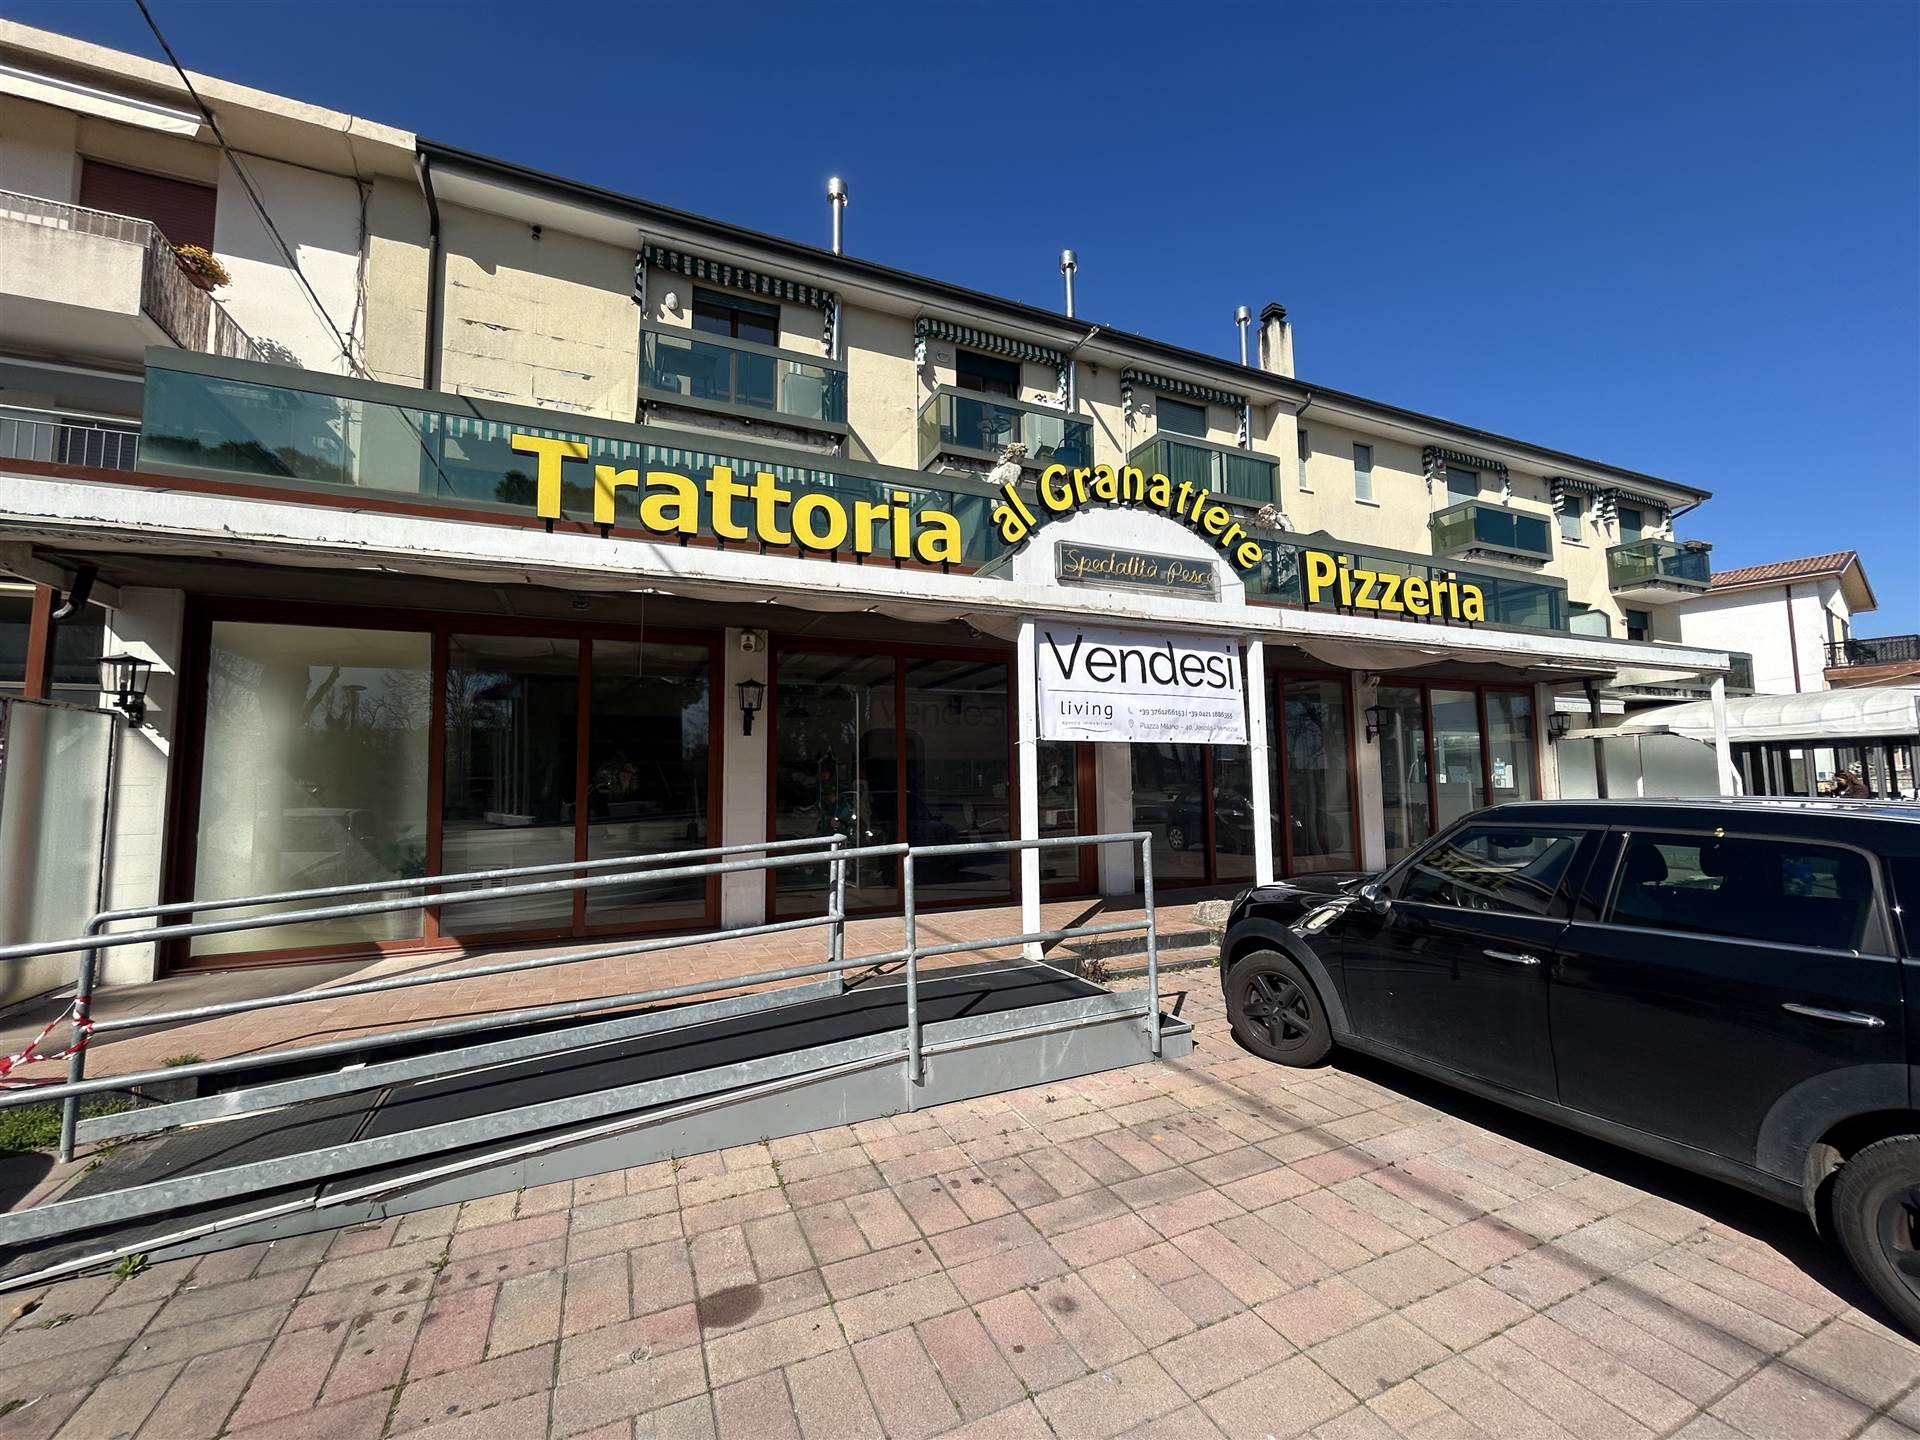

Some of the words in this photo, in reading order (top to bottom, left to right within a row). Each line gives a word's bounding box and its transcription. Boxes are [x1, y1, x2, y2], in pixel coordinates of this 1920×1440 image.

[511, 433, 962, 565] Trattoria
[991, 482, 1037, 544] al
[1038, 463, 1264, 569] Granatiere
[1304, 550, 1485, 622] Pizzeria
[1044, 631, 1235, 690] Vendesi
[1060, 700, 1113, 719] living
